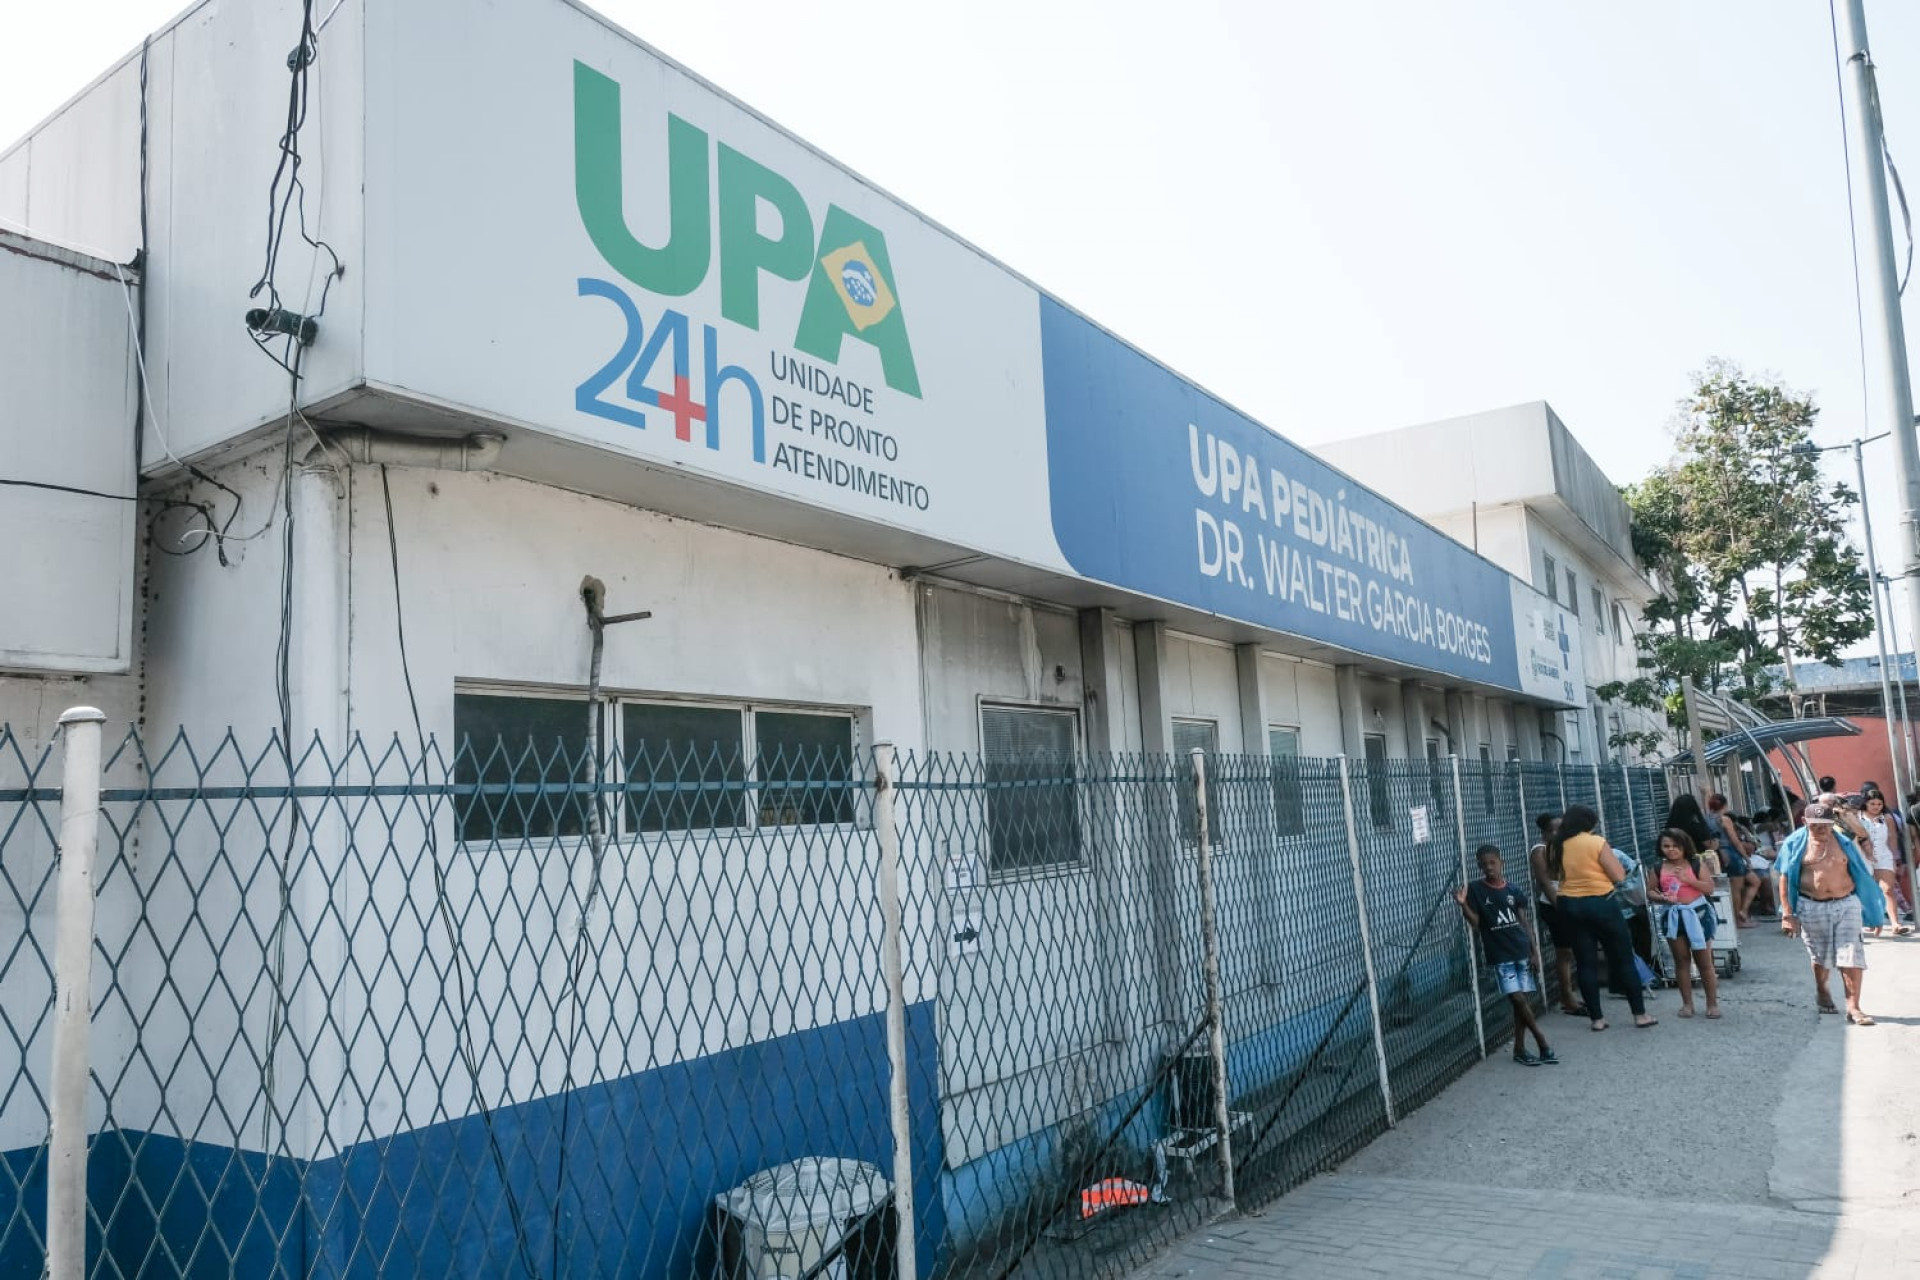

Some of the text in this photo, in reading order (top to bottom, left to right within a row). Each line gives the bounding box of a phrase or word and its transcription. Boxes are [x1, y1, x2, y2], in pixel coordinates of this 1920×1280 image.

[573, 58, 923, 400] UPA
[575, 277, 767, 464] 24h
[771, 350, 874, 414] UNIDADE
[772, 396, 898, 462] DE PRONTO
[773, 443, 930, 511] ATENDIMENTO
[1188, 423, 1414, 586] UPA PEDIÁTRICA
[1196, 508, 1491, 665] DR. WALTER GARCIA BORGES
